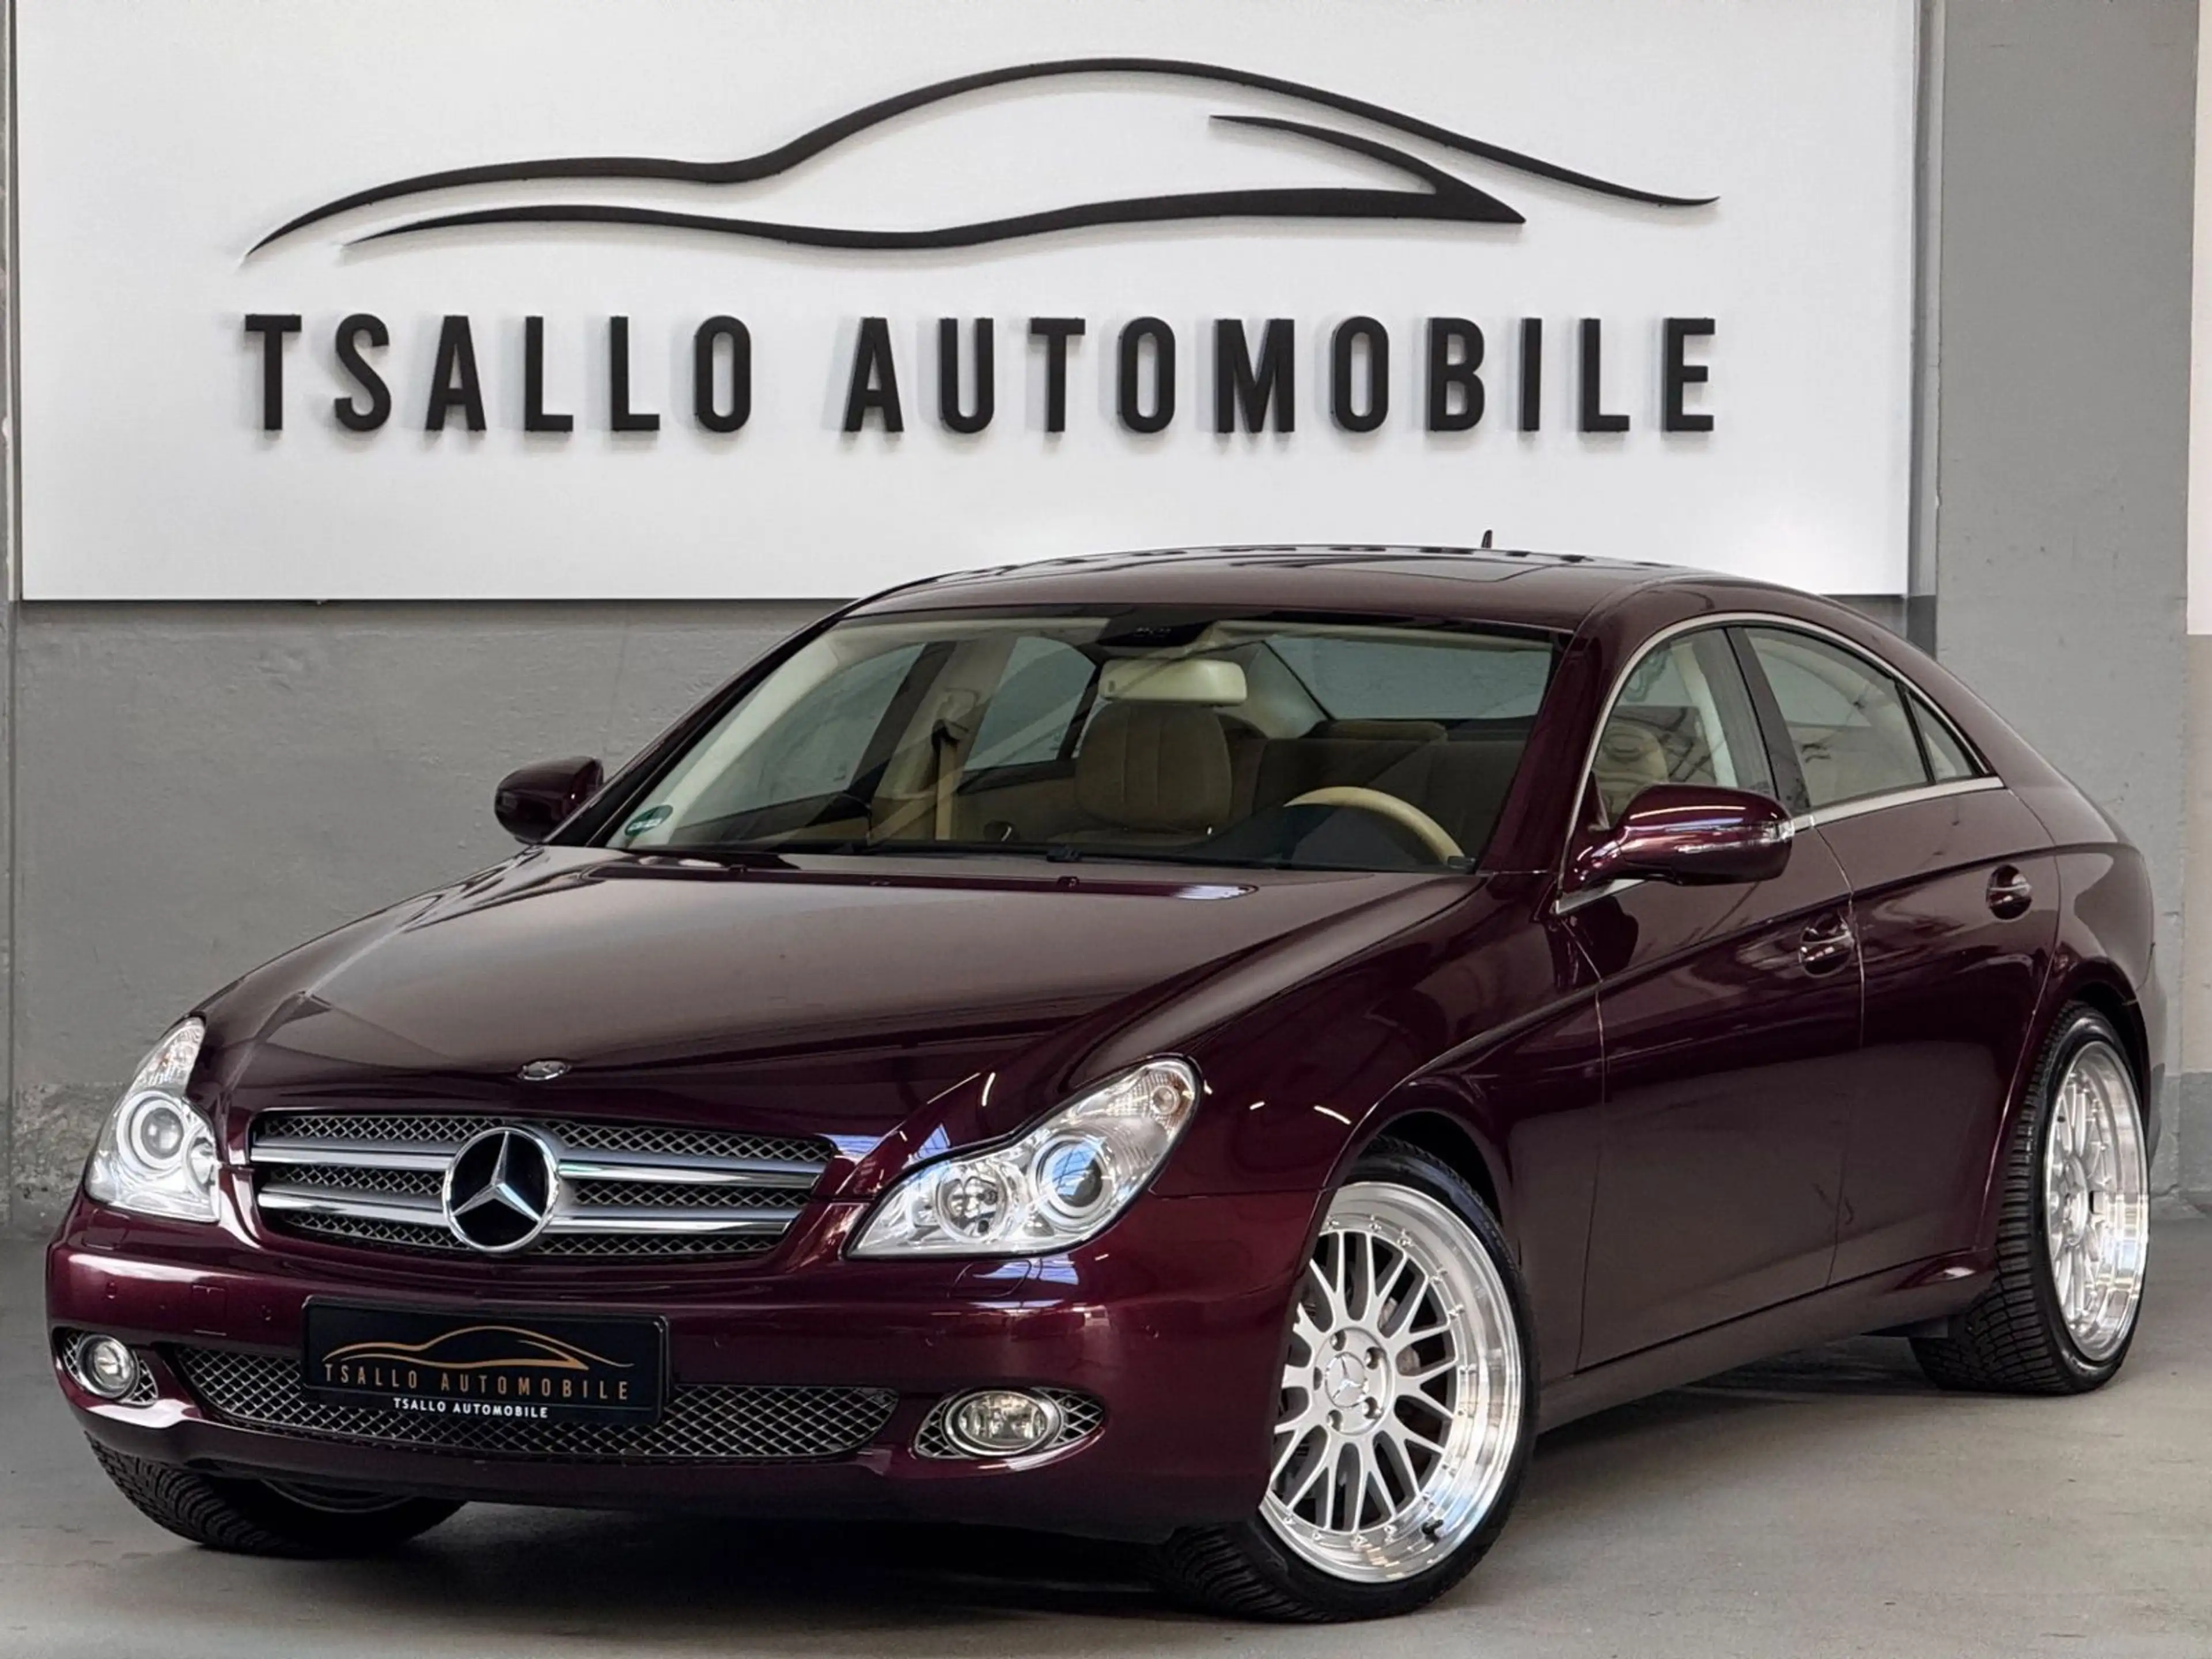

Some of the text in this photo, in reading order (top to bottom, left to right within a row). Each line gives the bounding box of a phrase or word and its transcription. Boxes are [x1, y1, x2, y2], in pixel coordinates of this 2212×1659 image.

[245, 313, 1716, 433] TSALLO AUTOMOBILE
[324, 1363, 627, 1400] TSALLO AUTOMOBILE
[394, 1397, 548, 1418] TSALLO AUTOMOBILE
